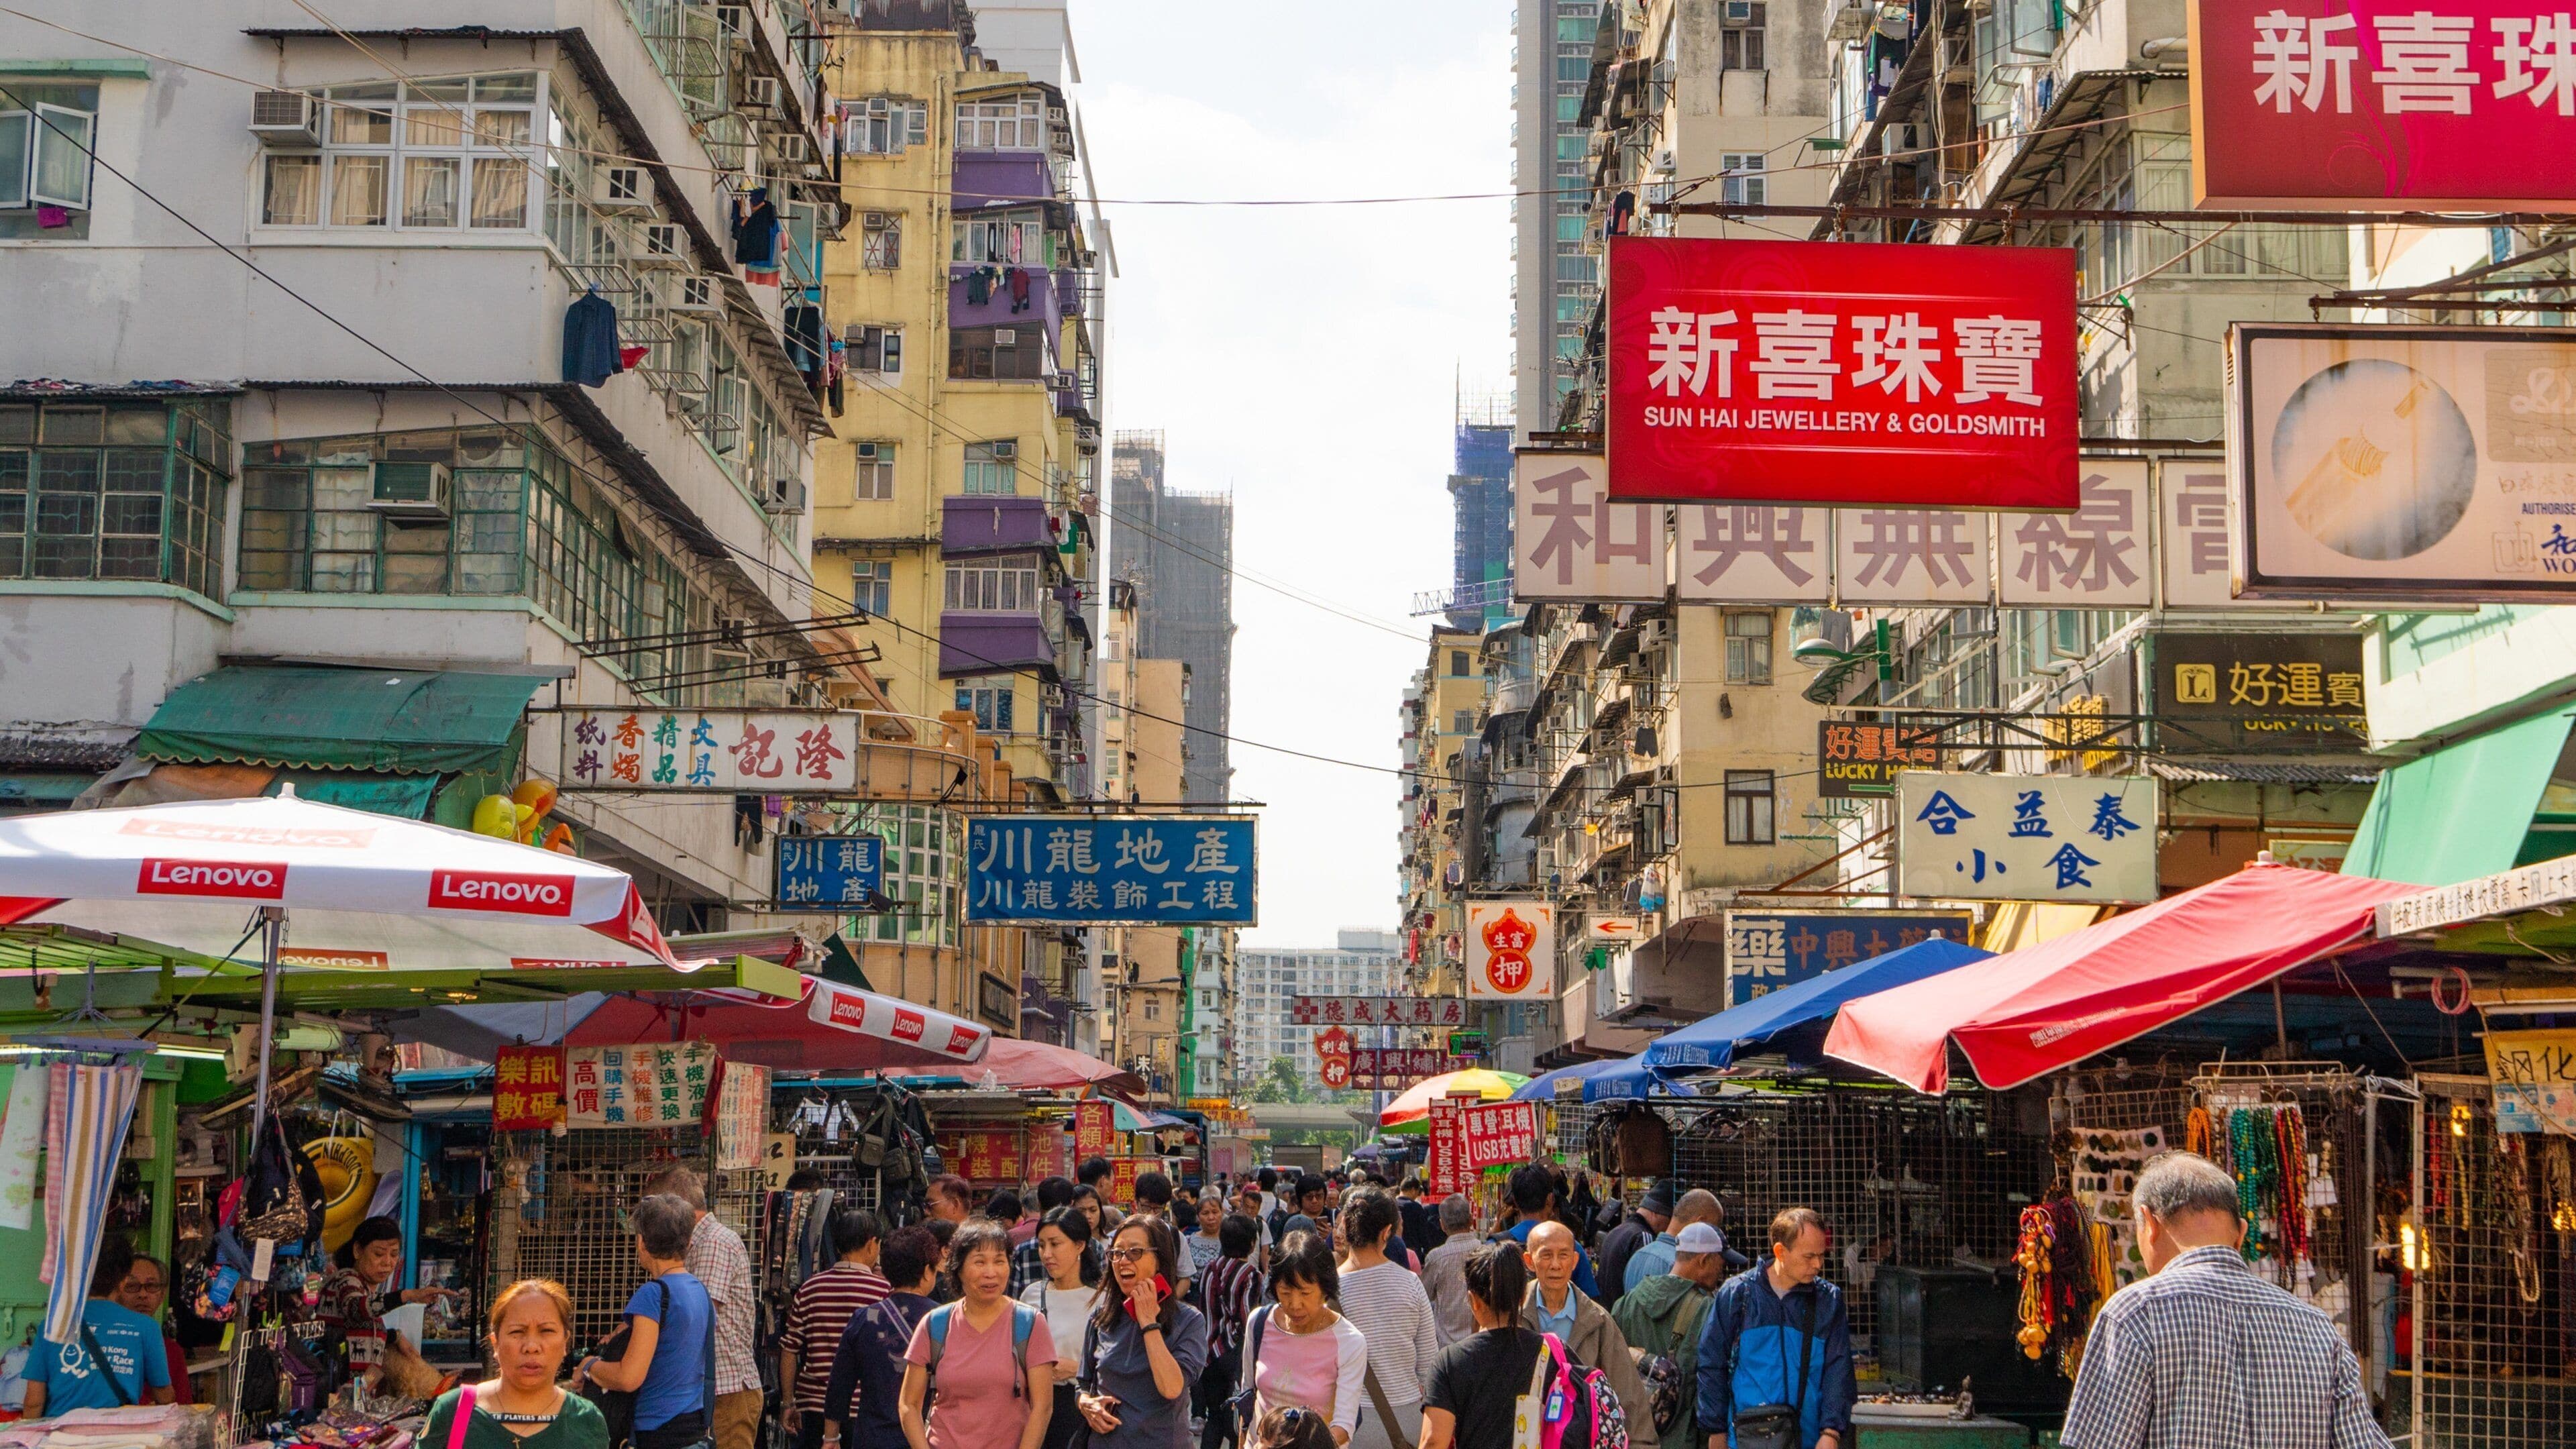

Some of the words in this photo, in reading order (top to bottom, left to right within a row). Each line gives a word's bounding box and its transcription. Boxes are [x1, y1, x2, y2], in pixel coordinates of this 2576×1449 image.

[1648, 306, 2043, 406] 新喜珠寶
[1644, 407, 1692, 427] SUN
[1699, 408, 1738, 429] HAI
[1744, 409, 1881, 432] JEWELLERY
[1886, 413, 1902, 433] &
[1909, 414, 2045, 437] GOLDSMITH
[1825, 763, 1878, 780] LUCKY
[786, 841, 874, 872] 川龍
[977, 827, 1240, 873] 川龍地產
[152, 861, 273, 887] Lenovo
[1956, 843, 2101, 890] 小食
[441, 874, 561, 904] Lenovo
[977, 879, 1238, 910] 川龍裝飾工程
[1732, 918, 1786, 977] 藥
[1494, 957, 1523, 986] 押
[834, 1000, 861, 1018] Lenovo
[895, 1016, 922, 1034] Lenovo
[498, 1055, 561, 1085] 樂訊
[658, 1049, 681, 1121] 快速更換
[1327, 1064, 1346, 1083] 押
[574, 1059, 599, 1114] 高價
[604, 1051, 625, 1122] 回購手機
[108, 1346, 128, 1356] Kong
[113, 1355, 134, 1365] Race
